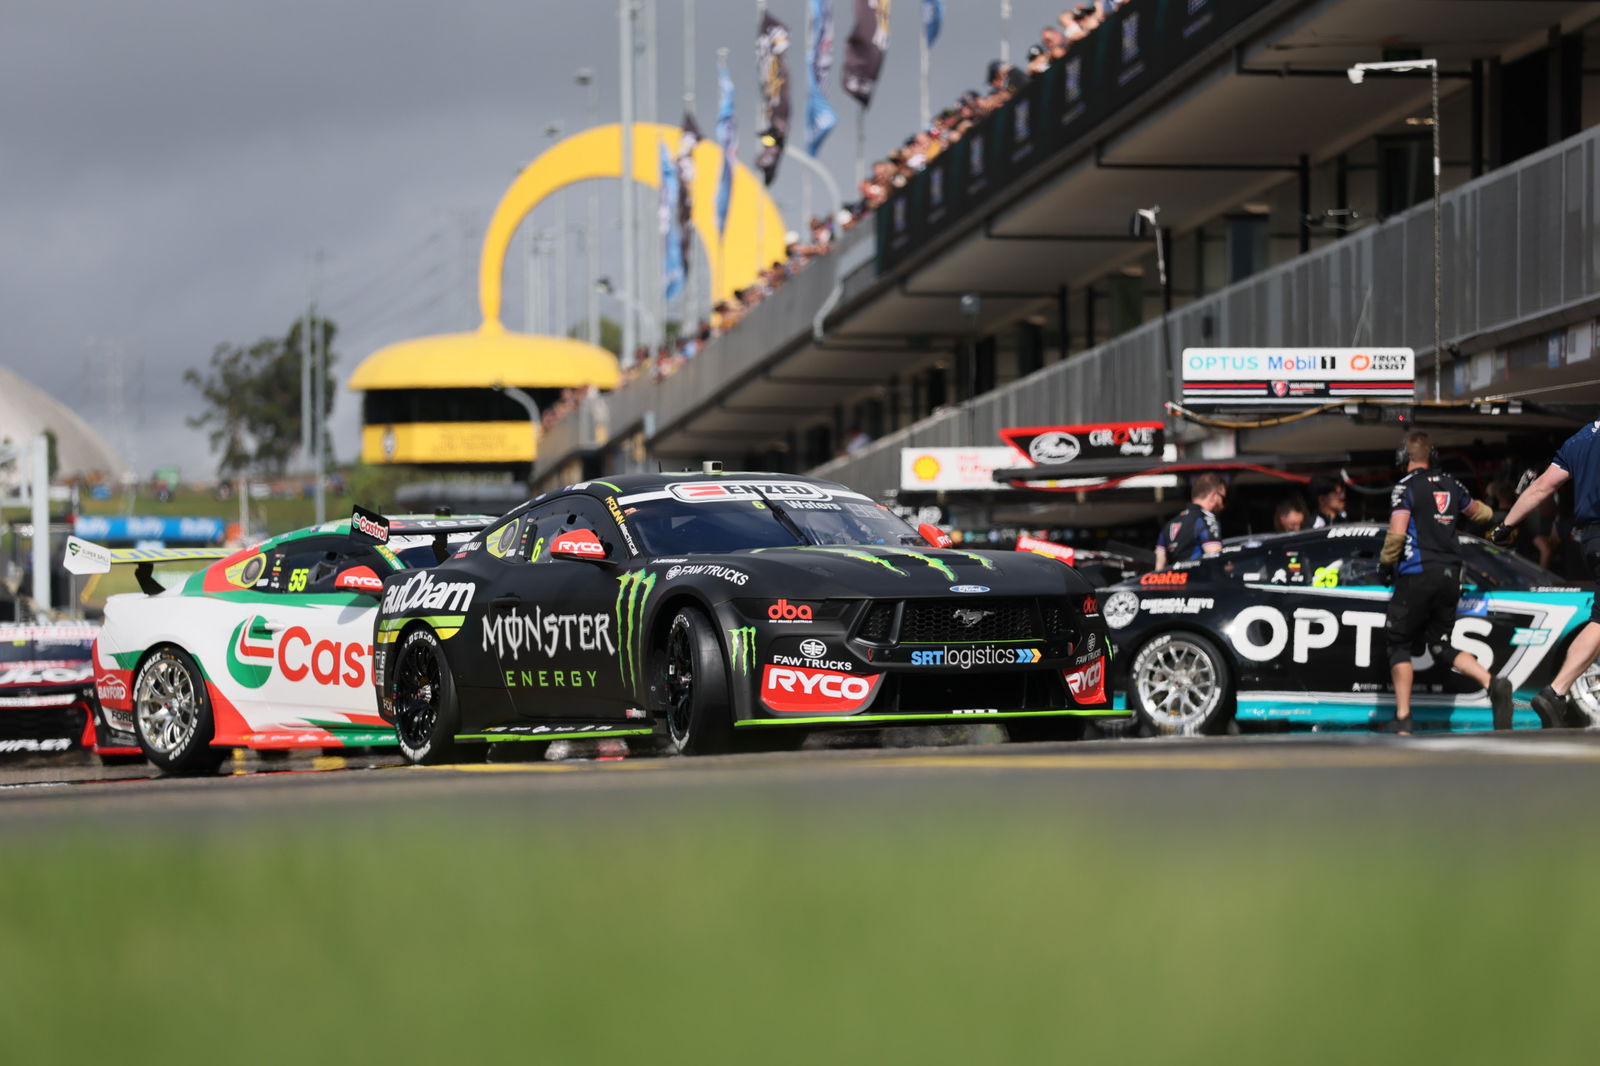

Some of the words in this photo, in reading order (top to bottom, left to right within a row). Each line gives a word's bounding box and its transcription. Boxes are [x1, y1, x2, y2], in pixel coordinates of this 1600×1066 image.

[1189, 355, 1259, 371] OPTUS
[1268, 355, 1316, 370] Mobil
[1089, 427, 1152, 446] GROVE
[724, 485, 812, 495] ENZED
[752, 500, 766, 509] 6
[784, 500, 842, 510] Waters
[359, 515, 389, 542] Castrol
[530, 537, 544, 562] 6
[558, 541, 603, 552] RYCO
[288, 568, 309, 592] 55
[343, 575, 383, 586] RYCO
[679, 565, 706, 576] FAW
[703, 565, 749, 586] TRUCKS
[1313, 567, 1339, 588] 25
[768, 598, 813, 620] dba
[408, 631, 437, 647] DUNLOP
[481, 605, 616, 660] MONSTER
[1231, 605, 1494, 674] OPTS
[1509, 627, 1552, 646] 25
[278, 626, 375, 689] Cas
[773, 654, 803, 665] FAW
[804, 657, 852, 671] TRUCKS
[505, 670, 597, 687] ENERGY
[768, 668, 869, 700] RYCO
[1066, 661, 1102, 695] RYCO
